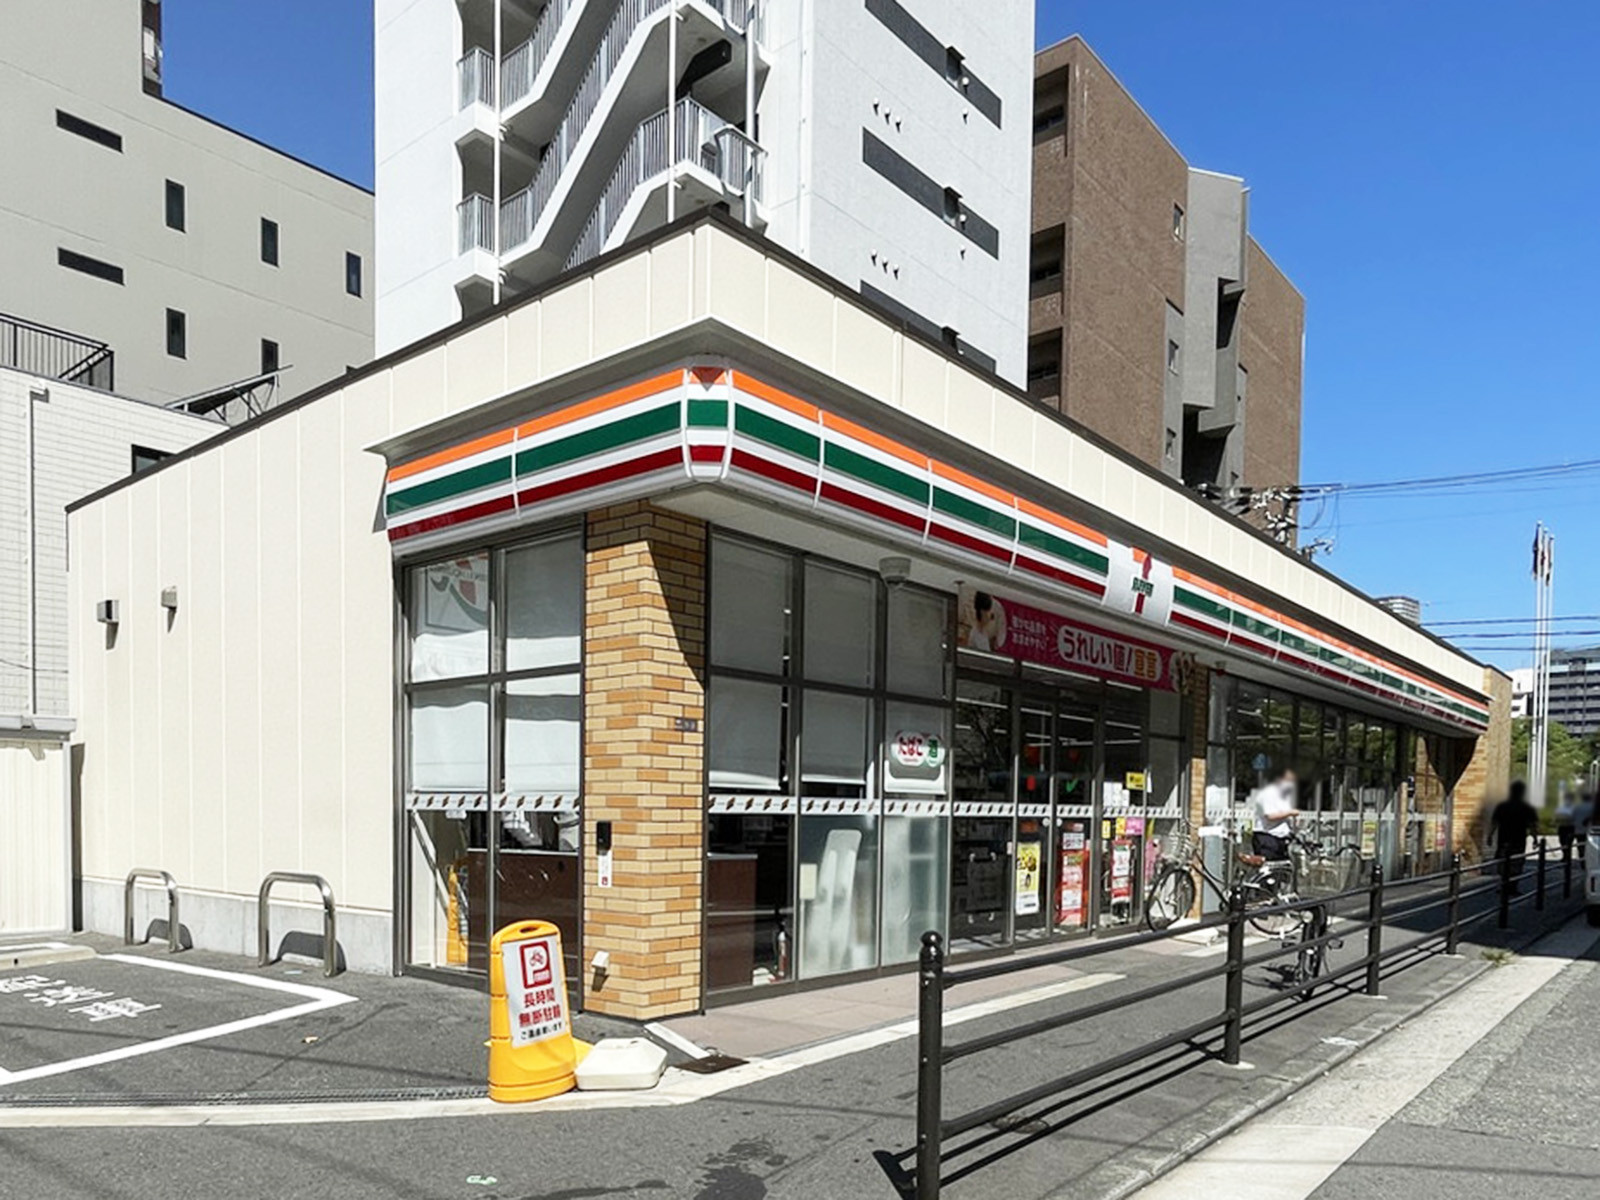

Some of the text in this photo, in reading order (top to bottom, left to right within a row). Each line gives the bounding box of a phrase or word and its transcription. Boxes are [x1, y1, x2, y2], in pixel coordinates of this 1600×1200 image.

[898, 735, 924, 756] たばこ
[524, 988, 555, 1008] 長時間
